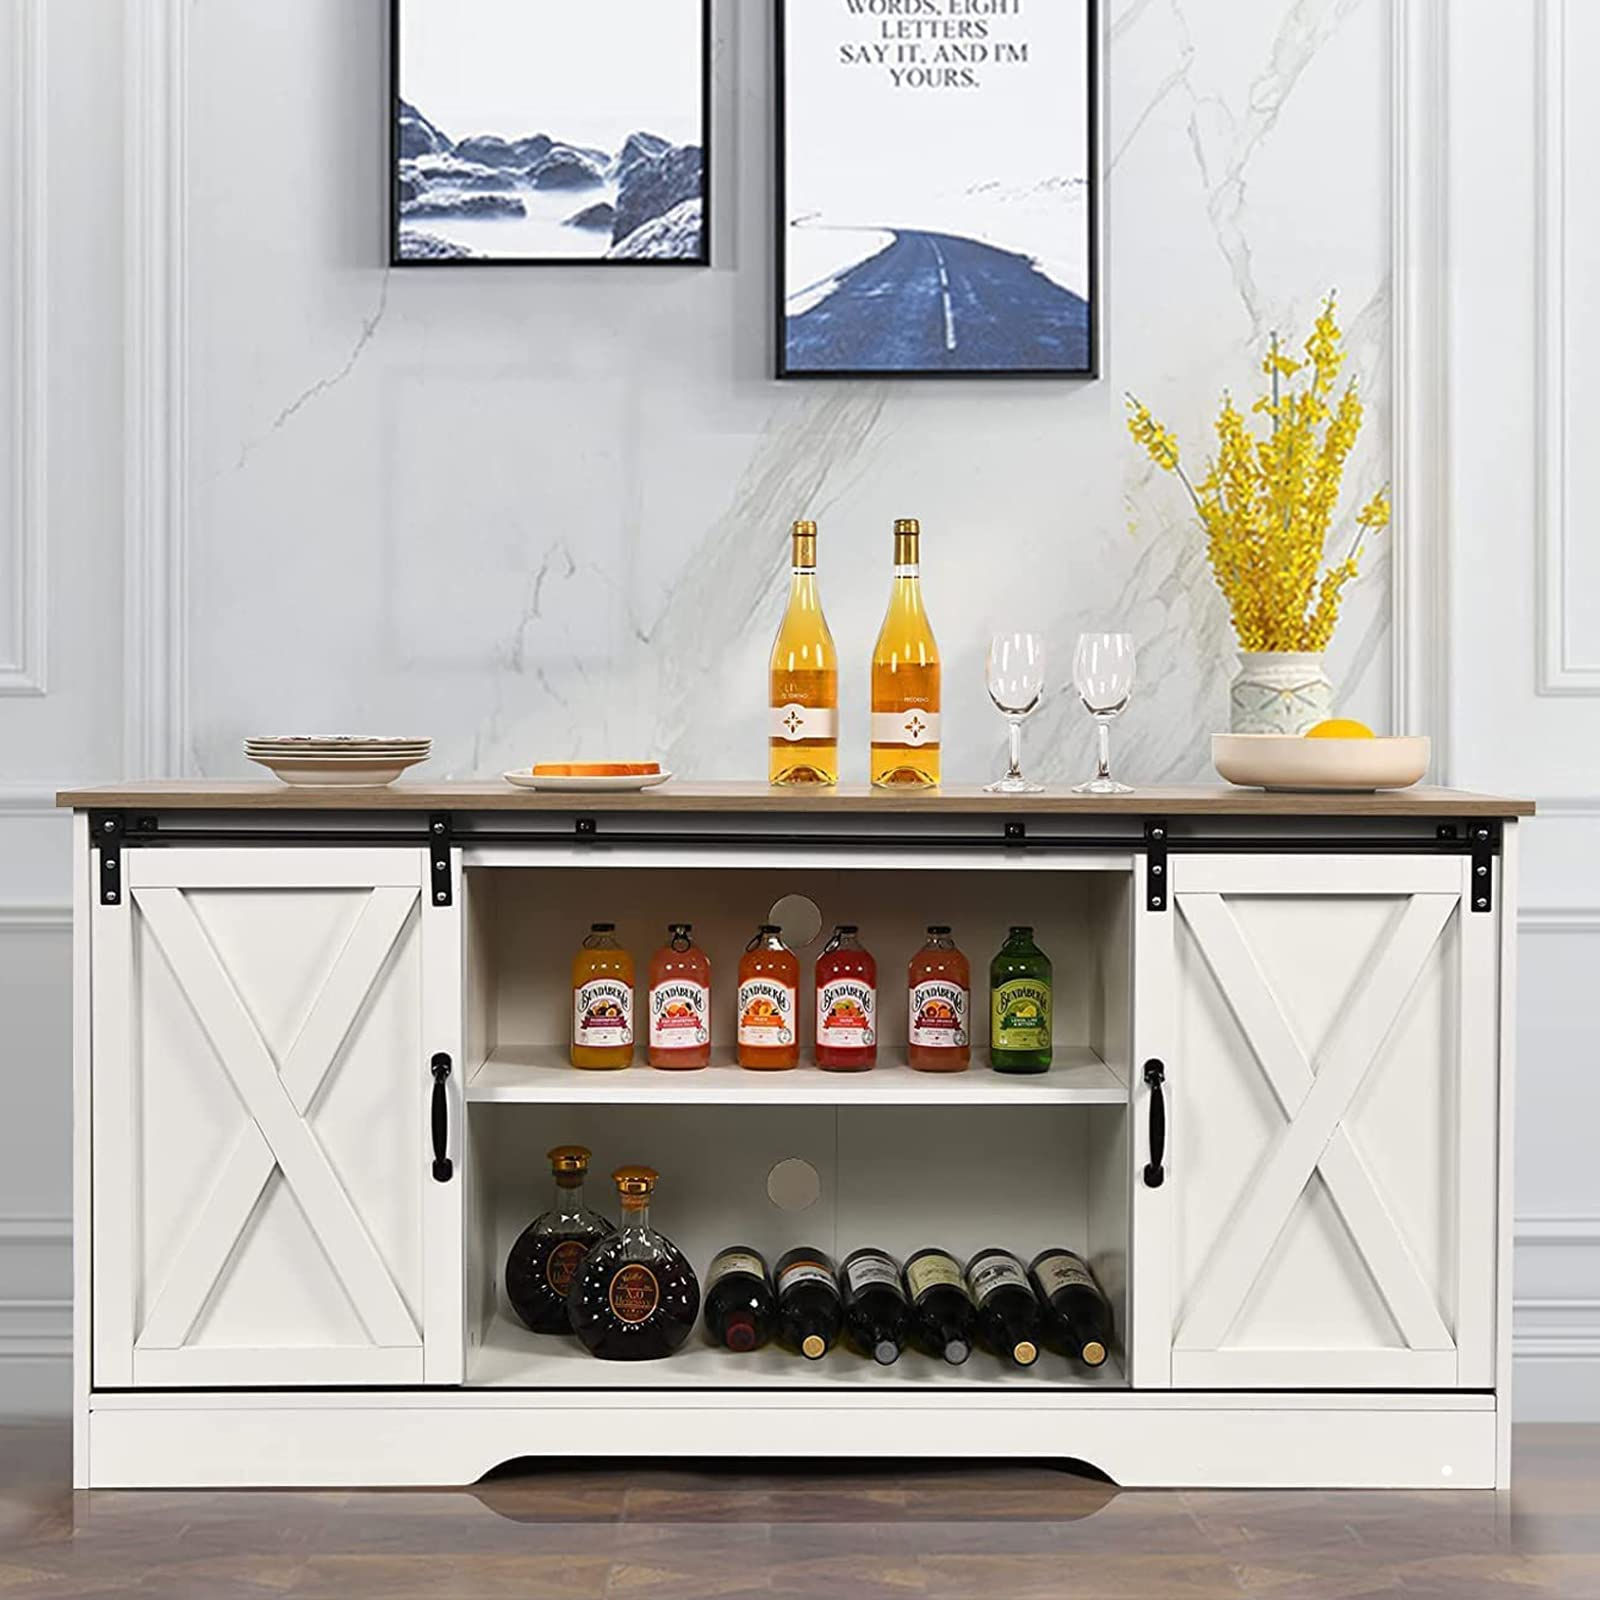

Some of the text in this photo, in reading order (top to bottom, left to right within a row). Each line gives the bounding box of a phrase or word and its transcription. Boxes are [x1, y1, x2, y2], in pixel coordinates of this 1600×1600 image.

[949, 0, 1021, 15] EIGHT
[881, 20, 989, 39] LETTERS
[840, 44, 889, 64] SAY
[933, 44, 989, 63] AND
[994, 43, 1029, 63] I'M
[889, 68, 981, 88] YOURS.
